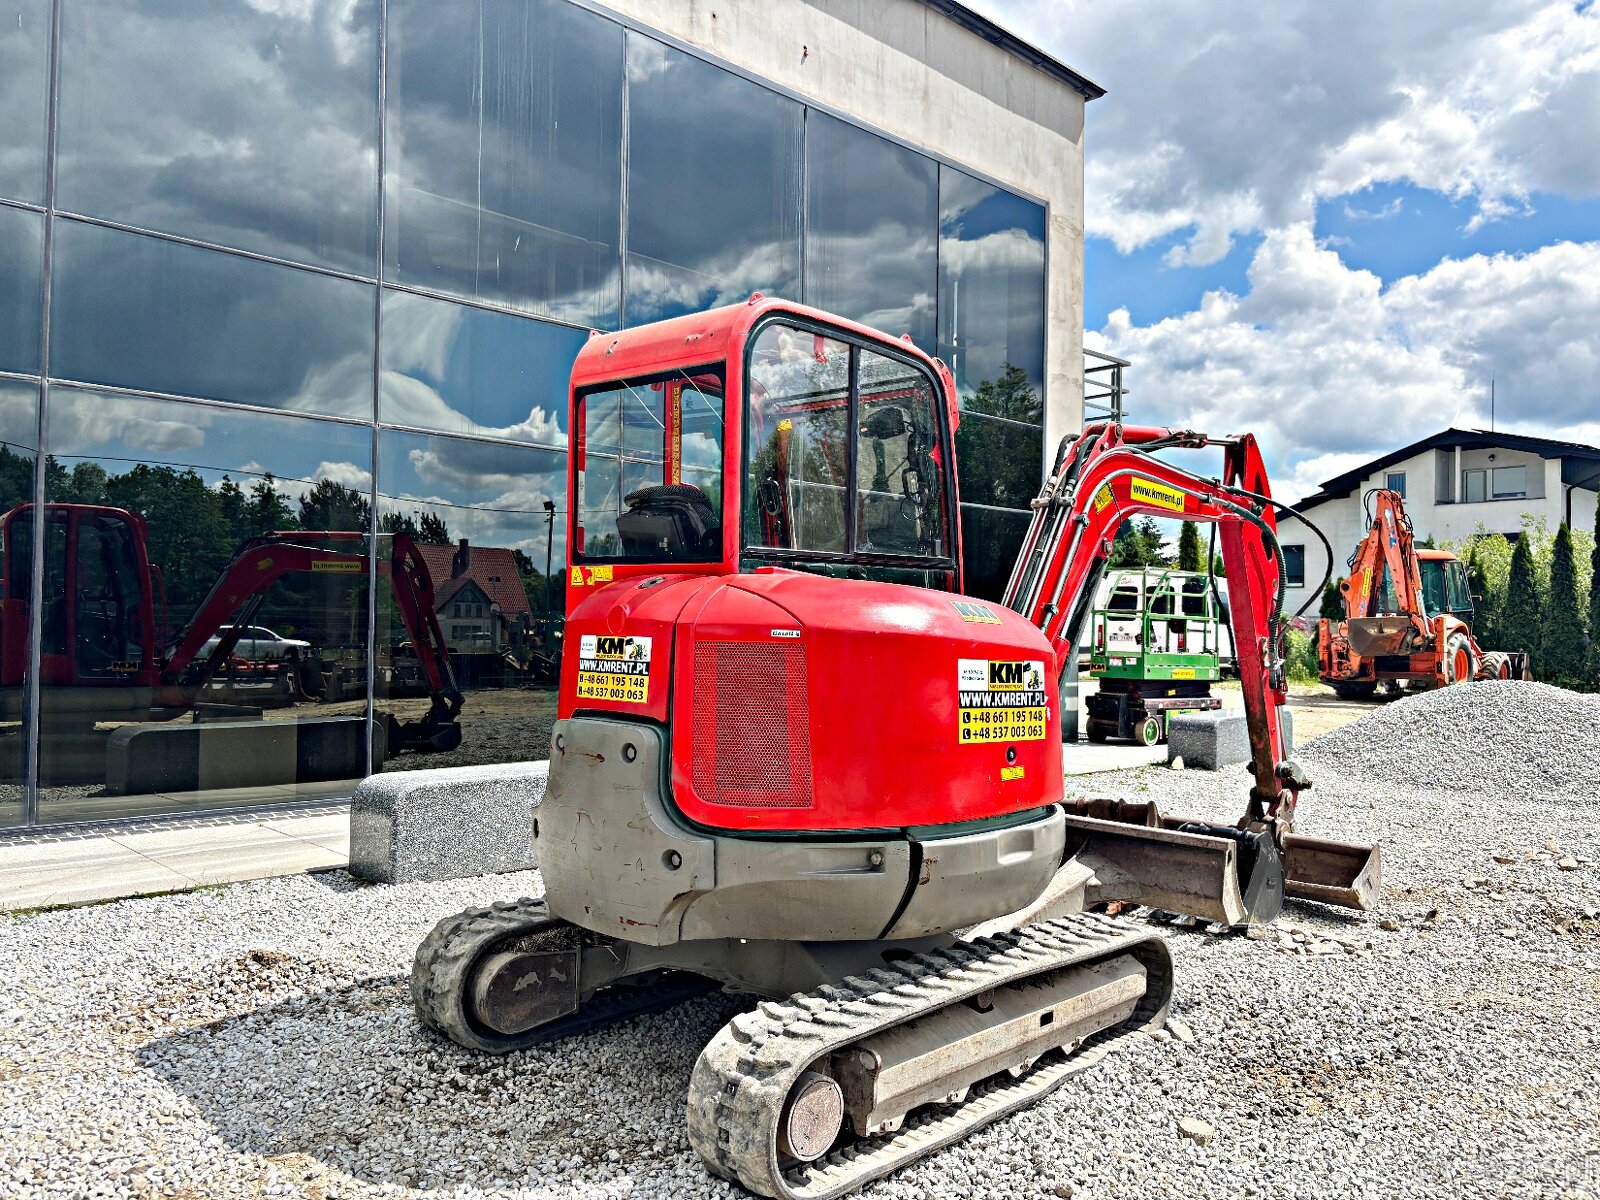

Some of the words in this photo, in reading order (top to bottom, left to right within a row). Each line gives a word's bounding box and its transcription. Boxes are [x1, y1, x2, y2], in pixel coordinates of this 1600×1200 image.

[1132, 484, 1183, 508] www.kmrent.pl
[951, 600, 998, 619] KM
[596, 637, 626, 655] KM
[580, 659, 649, 675] WWW.KMRENT.PL
[990, 662, 1023, 684] KM
[596, 675, 609, 686] 661
[611, 676, 626, 687] 195
[628, 677, 645, 688] 148
[595, 687, 609, 697] 537
[610, 688, 625, 699] 003
[626, 689, 644, 700] 063
[959, 691, 1045, 707] WWW.KMRENT.PL
[972, 711, 991, 724] +48
[992, 711, 1009, 724] 661
[1011, 710, 1026, 723] 195
[1028, 710, 1043, 722] 148
[972, 727, 990, 739] +48
[992, 726, 1009, 739] 537
[1010, 725, 1026, 738] 003
[1027, 725, 1043, 738] 063
